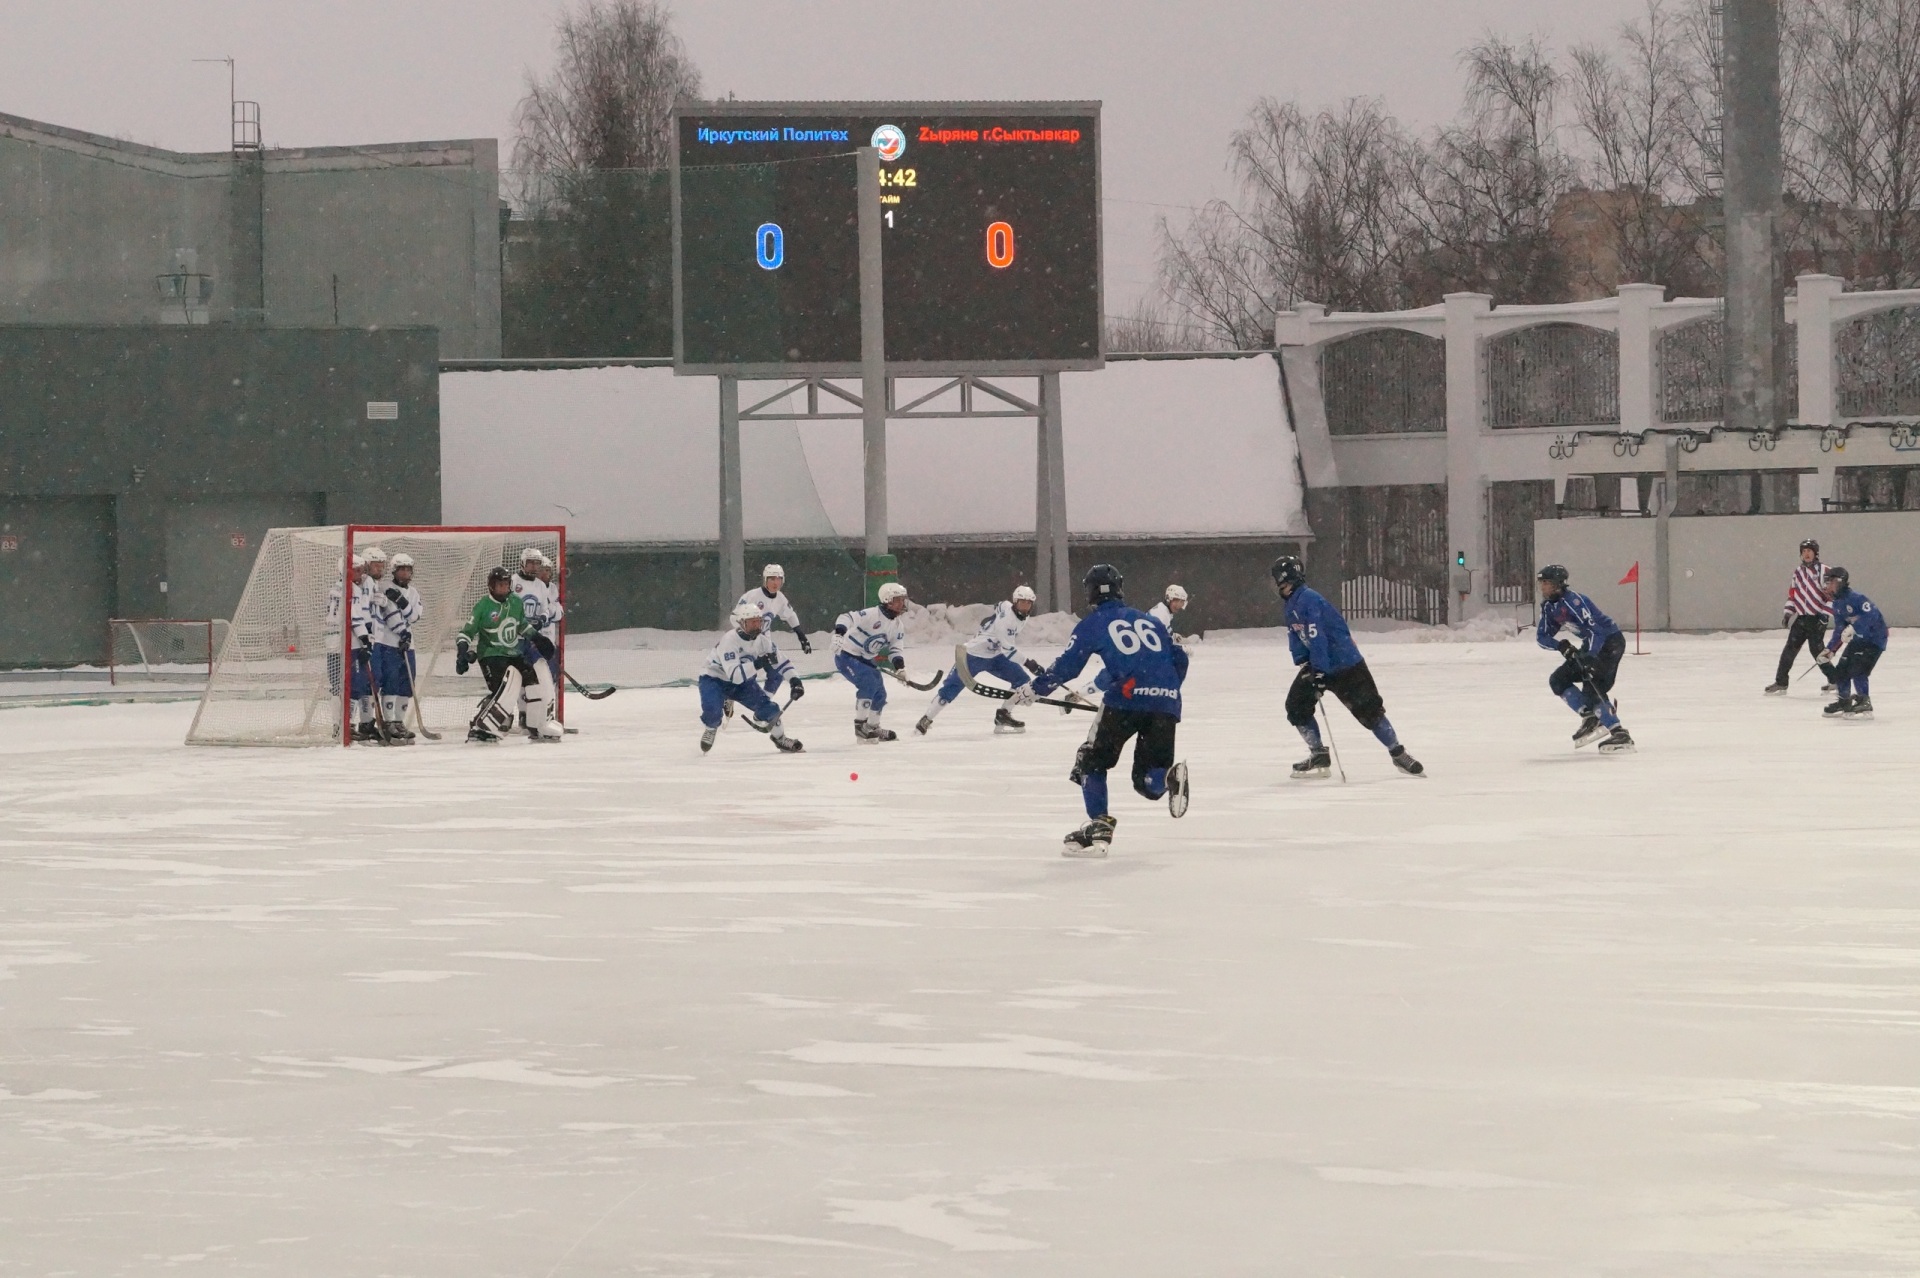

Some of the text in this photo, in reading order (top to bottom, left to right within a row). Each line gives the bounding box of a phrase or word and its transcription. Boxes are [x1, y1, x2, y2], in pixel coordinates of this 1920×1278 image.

[698, 127, 849, 143] Иркутский Политех
[918, 126, 1079, 142] Zыряне г.Сыктывкар
[884, 211, 893, 229] 1
[756, 223, 783, 270] 0
[987, 222, 1014, 268] 0
[1107, 618, 1162, 655] 66
[1308, 623, 1318, 638] 5
[724, 651, 736, 661] 89
